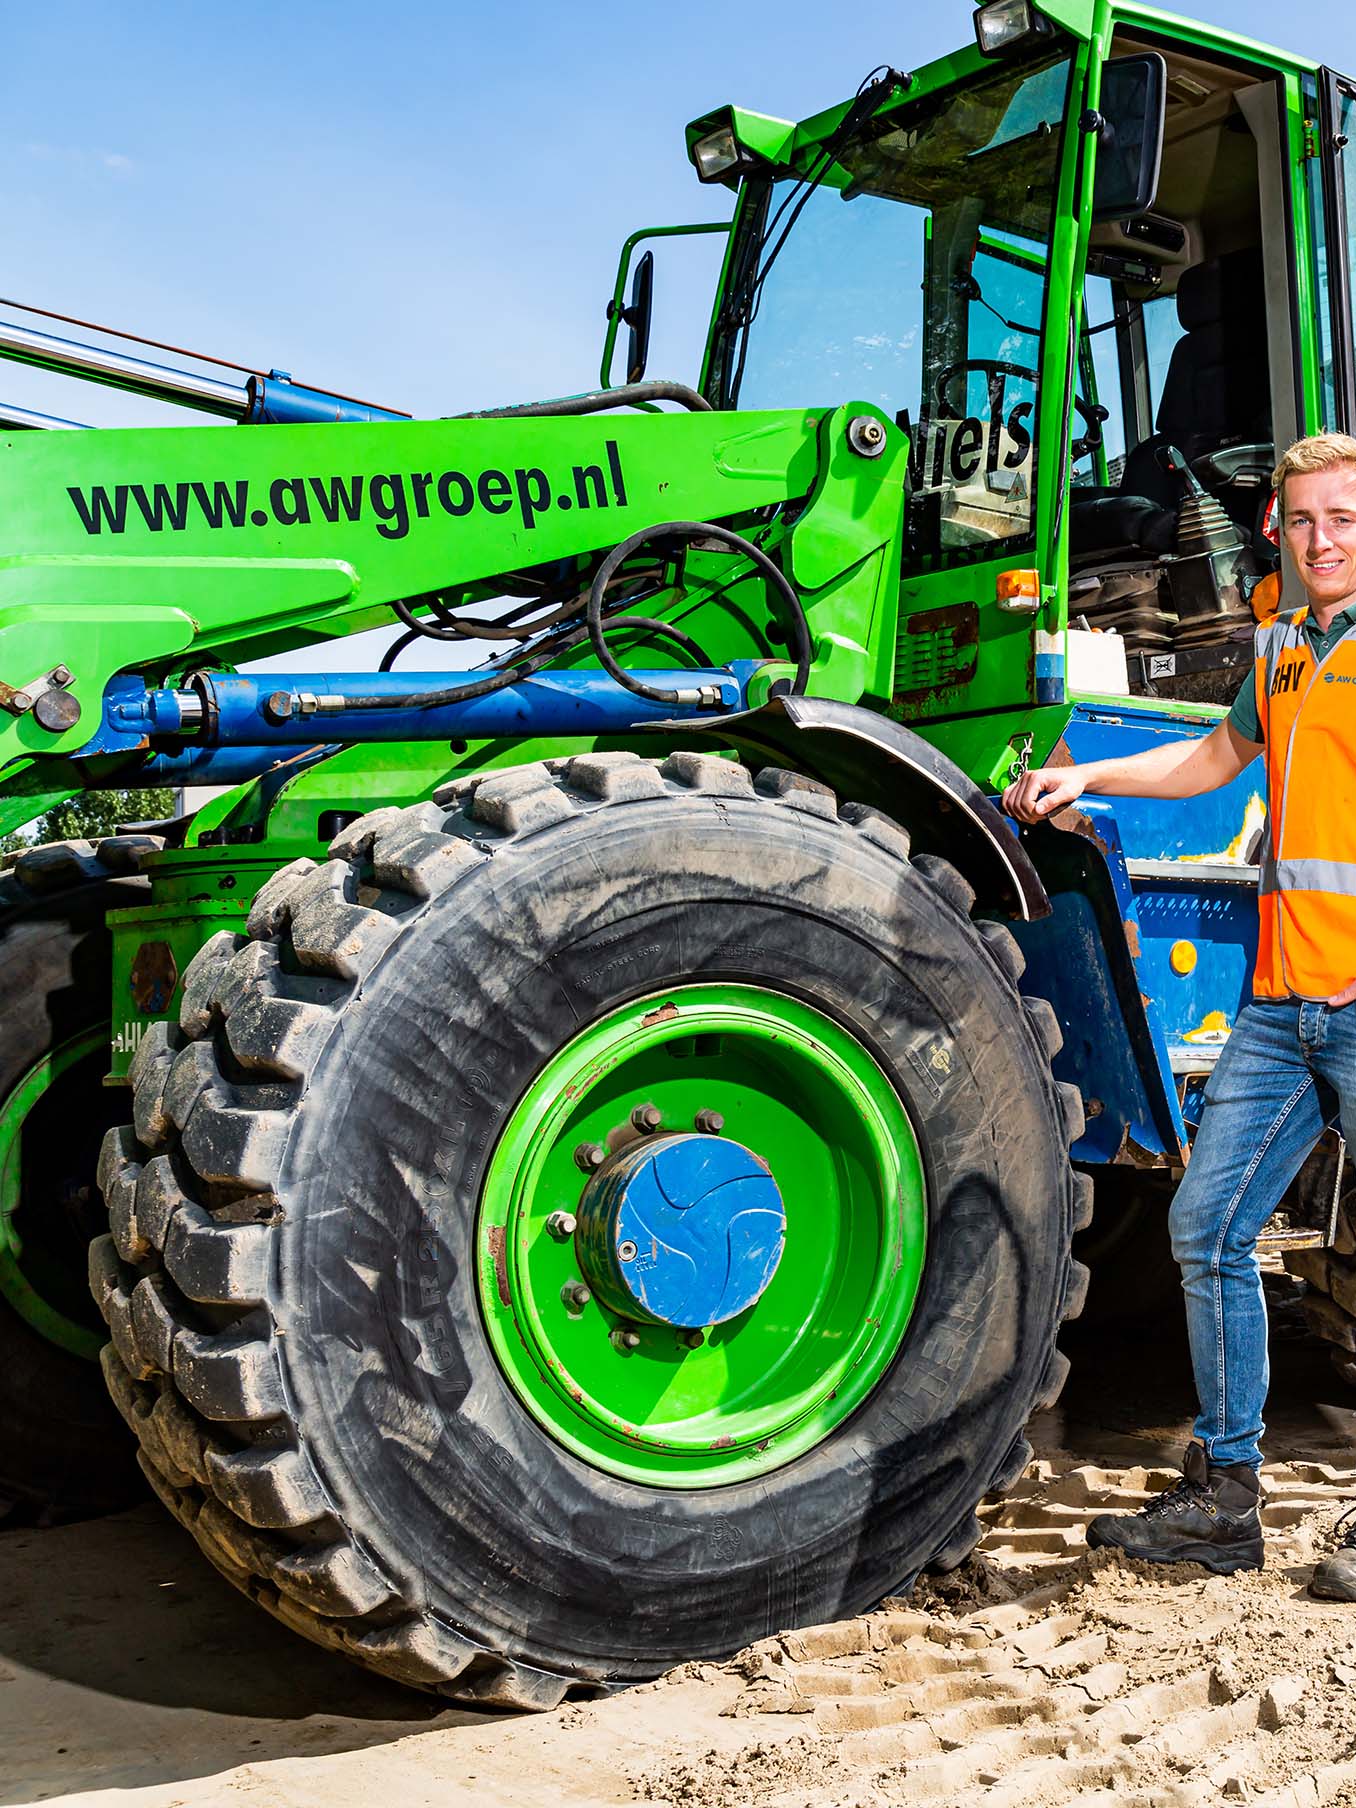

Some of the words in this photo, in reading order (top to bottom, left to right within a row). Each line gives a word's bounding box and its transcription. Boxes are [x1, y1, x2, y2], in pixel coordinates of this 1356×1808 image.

[896, 373, 1033, 493] Niels
[66, 440, 629, 540] www.awgroep.nl
[1271, 660, 1305, 697] BHV
[1336, 675, 1351, 684] AW
